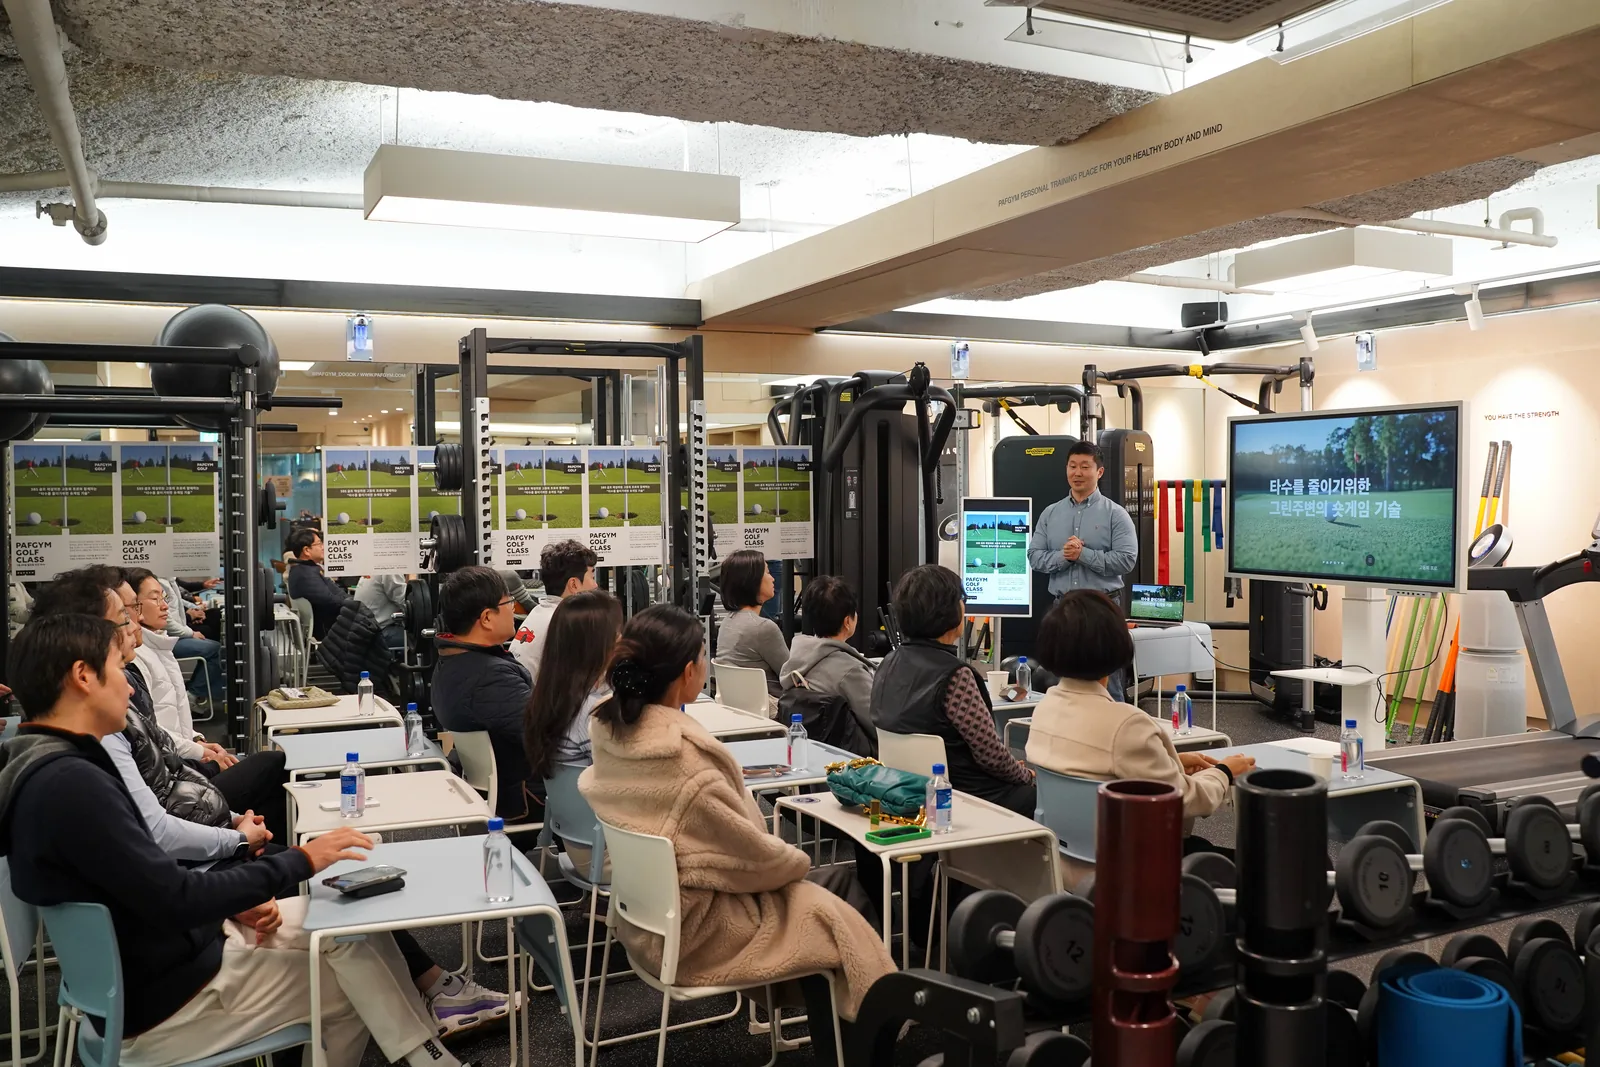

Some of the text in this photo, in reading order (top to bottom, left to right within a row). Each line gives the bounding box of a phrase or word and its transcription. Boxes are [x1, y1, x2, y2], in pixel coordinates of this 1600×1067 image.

[998, 124, 1223, 207] PAFGYM PERSONAL TRAINING PLACE FOR YOUR HEALTHY BODY AND MIND
[1270, 478, 1371, 495] 타수를 줄이기위한
[1269, 500, 1401, 518] 그린주변의 숏게임 기술
[1378, 872, 1389, 890] 10
[1066, 940, 1085, 964] 12
